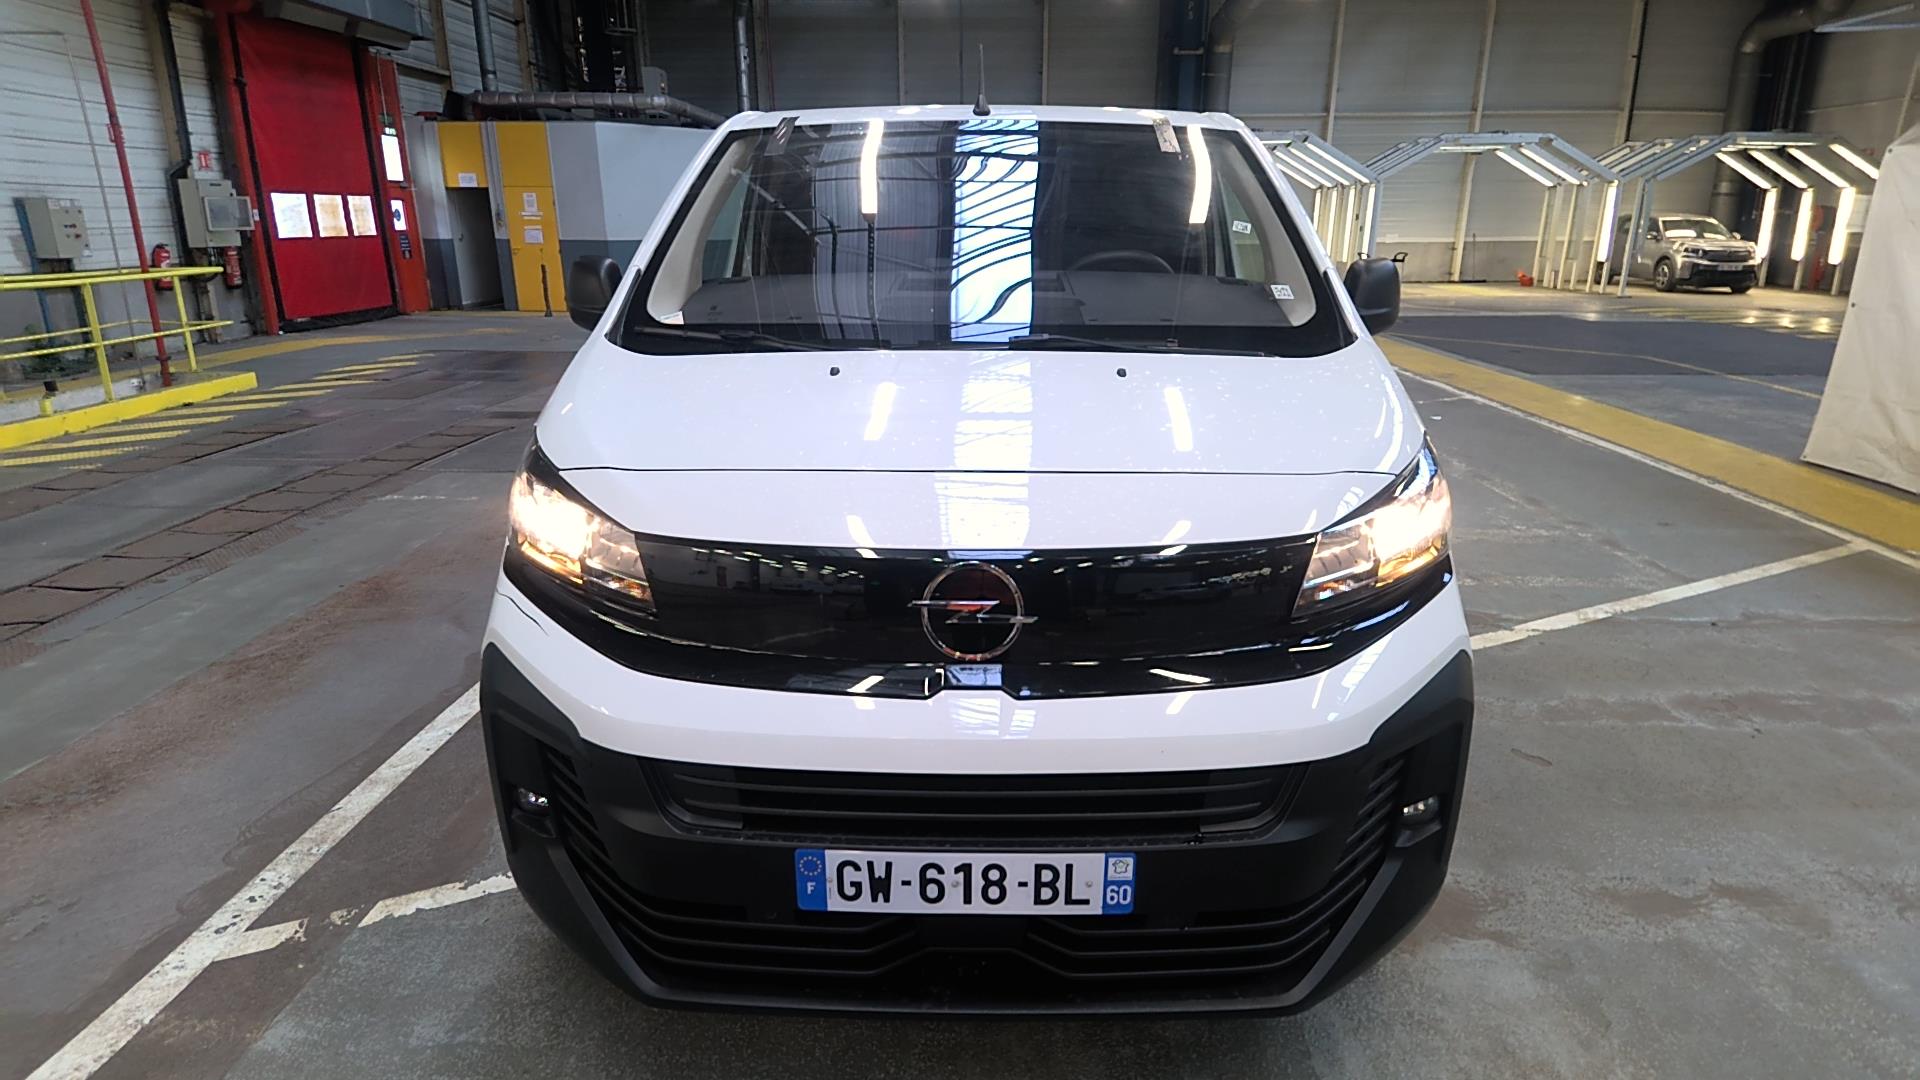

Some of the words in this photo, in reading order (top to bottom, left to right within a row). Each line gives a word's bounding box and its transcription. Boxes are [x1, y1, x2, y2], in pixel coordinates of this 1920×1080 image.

[807, 881, 816, 894] F
[835, 859, 1091, 906] GW-618-BL
[1106, 885, 1132, 905] 60
